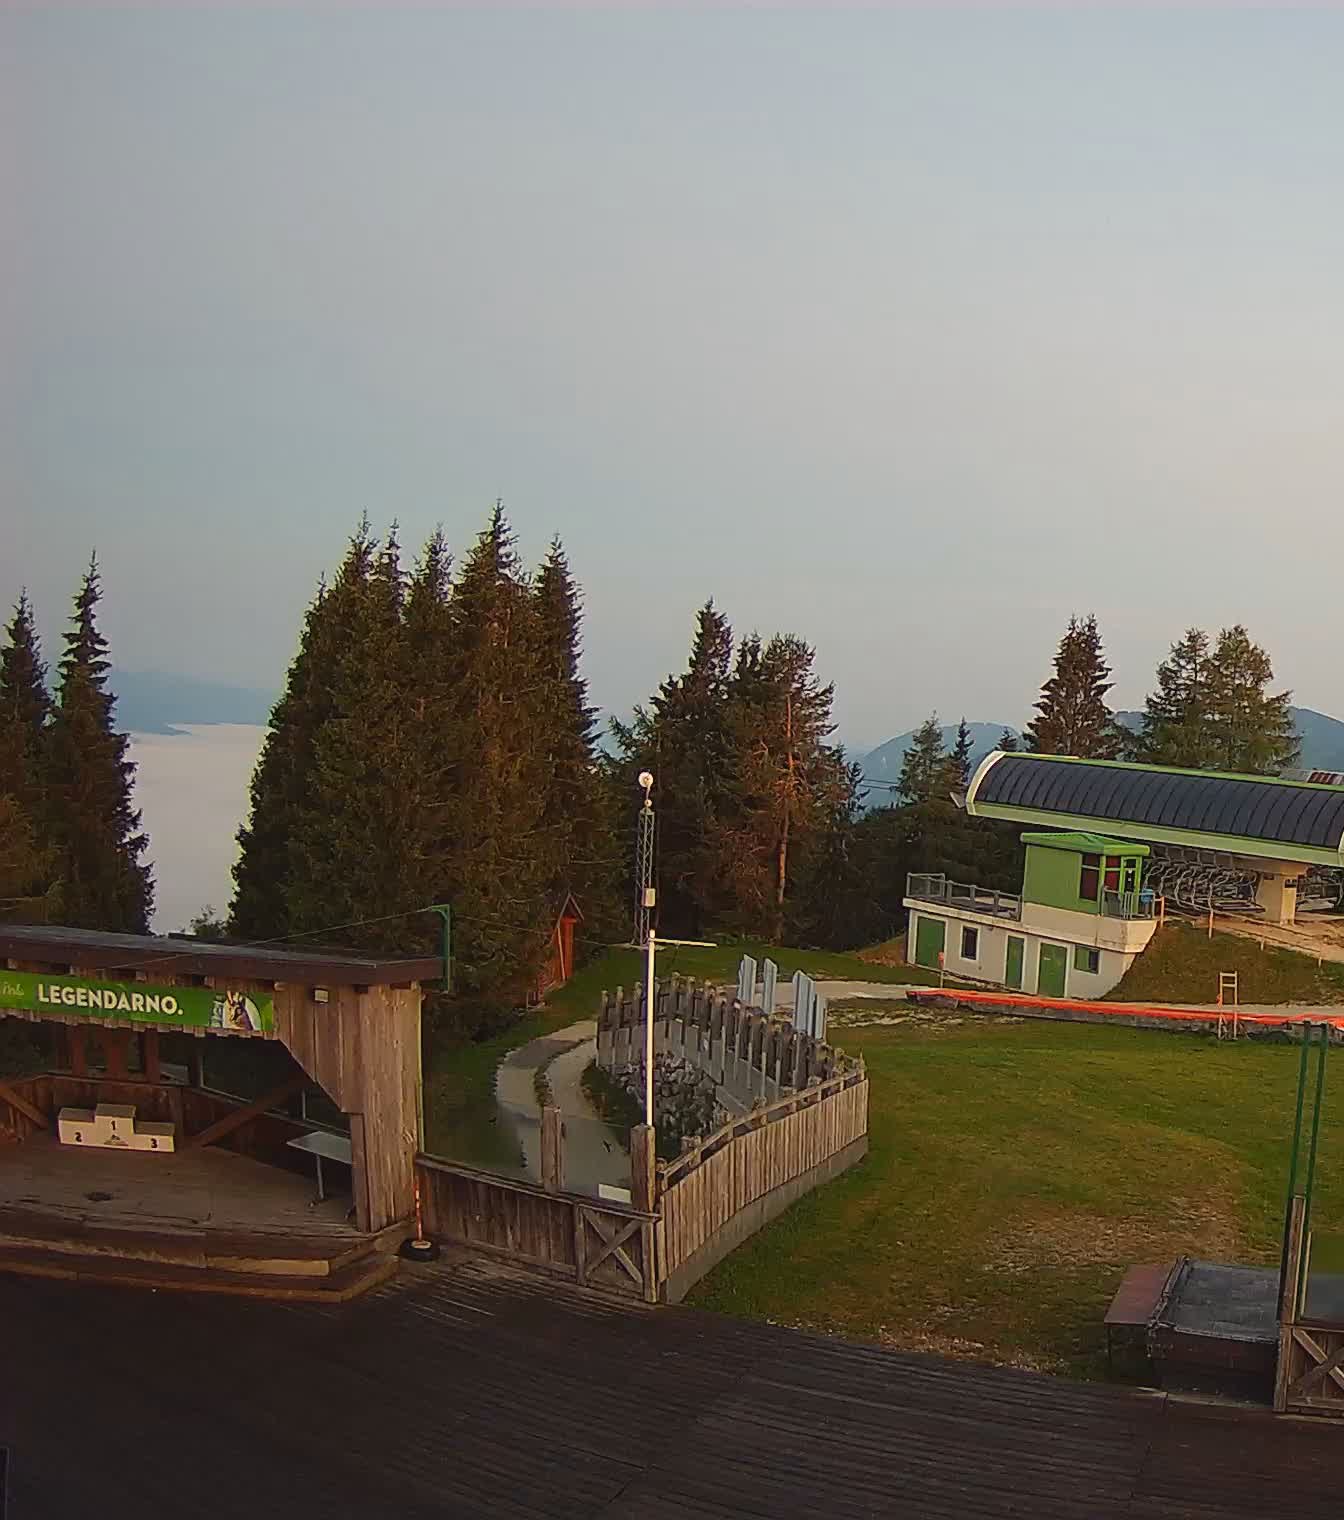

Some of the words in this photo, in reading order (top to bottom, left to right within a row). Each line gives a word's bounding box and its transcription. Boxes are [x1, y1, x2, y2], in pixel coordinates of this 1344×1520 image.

[38, 983, 183, 1015] LEGENDARNO.
[111, 1121, 116, 1130] 1
[75, 1132, 82, 1142] 2
[150, 1138, 158, 1148] 3
